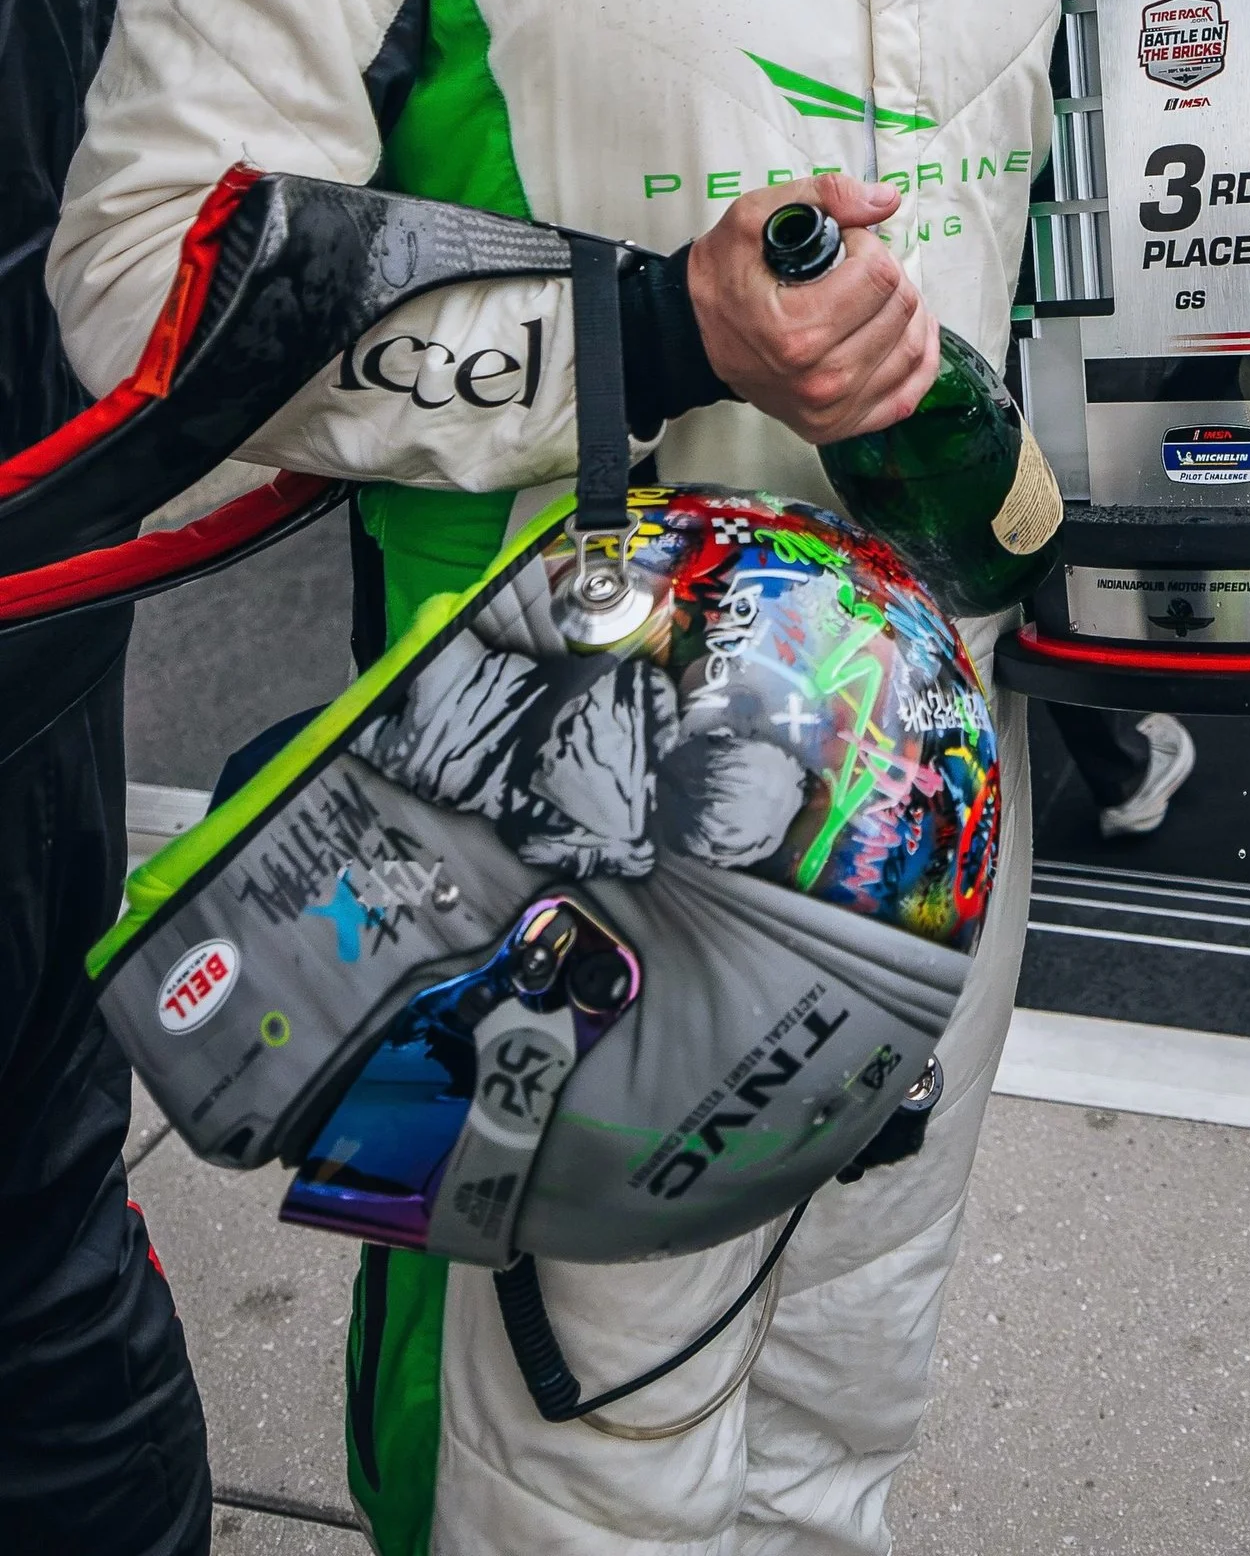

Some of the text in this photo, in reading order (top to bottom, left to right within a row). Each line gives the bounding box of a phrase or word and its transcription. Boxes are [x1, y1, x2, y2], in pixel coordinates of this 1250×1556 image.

[1150, 6, 1214, 23] TIRE RACK
[1144, 26, 1223, 47] BATTLE ON
[1143, 42, 1222, 61] THE BRICKS
[1179, 97, 1211, 109] IMSA
[644, 150, 1033, 199] PERGRINE
[1175, 290, 1206, 310] GS
[1203, 430, 1232, 440] IMSA
[1195, 453, 1249, 462] MICHELIN
[1180, 472, 1248, 481] PILOT CHALLENGE
[1097, 578, 1165, 592] INDIANAPOLIS
[1167, 580, 1206, 592] MOTOR
[165, 953, 229, 1020] BELL
[763, 983, 827, 1045] TACTICAL
[647, 1008, 851, 1201] TNVC
